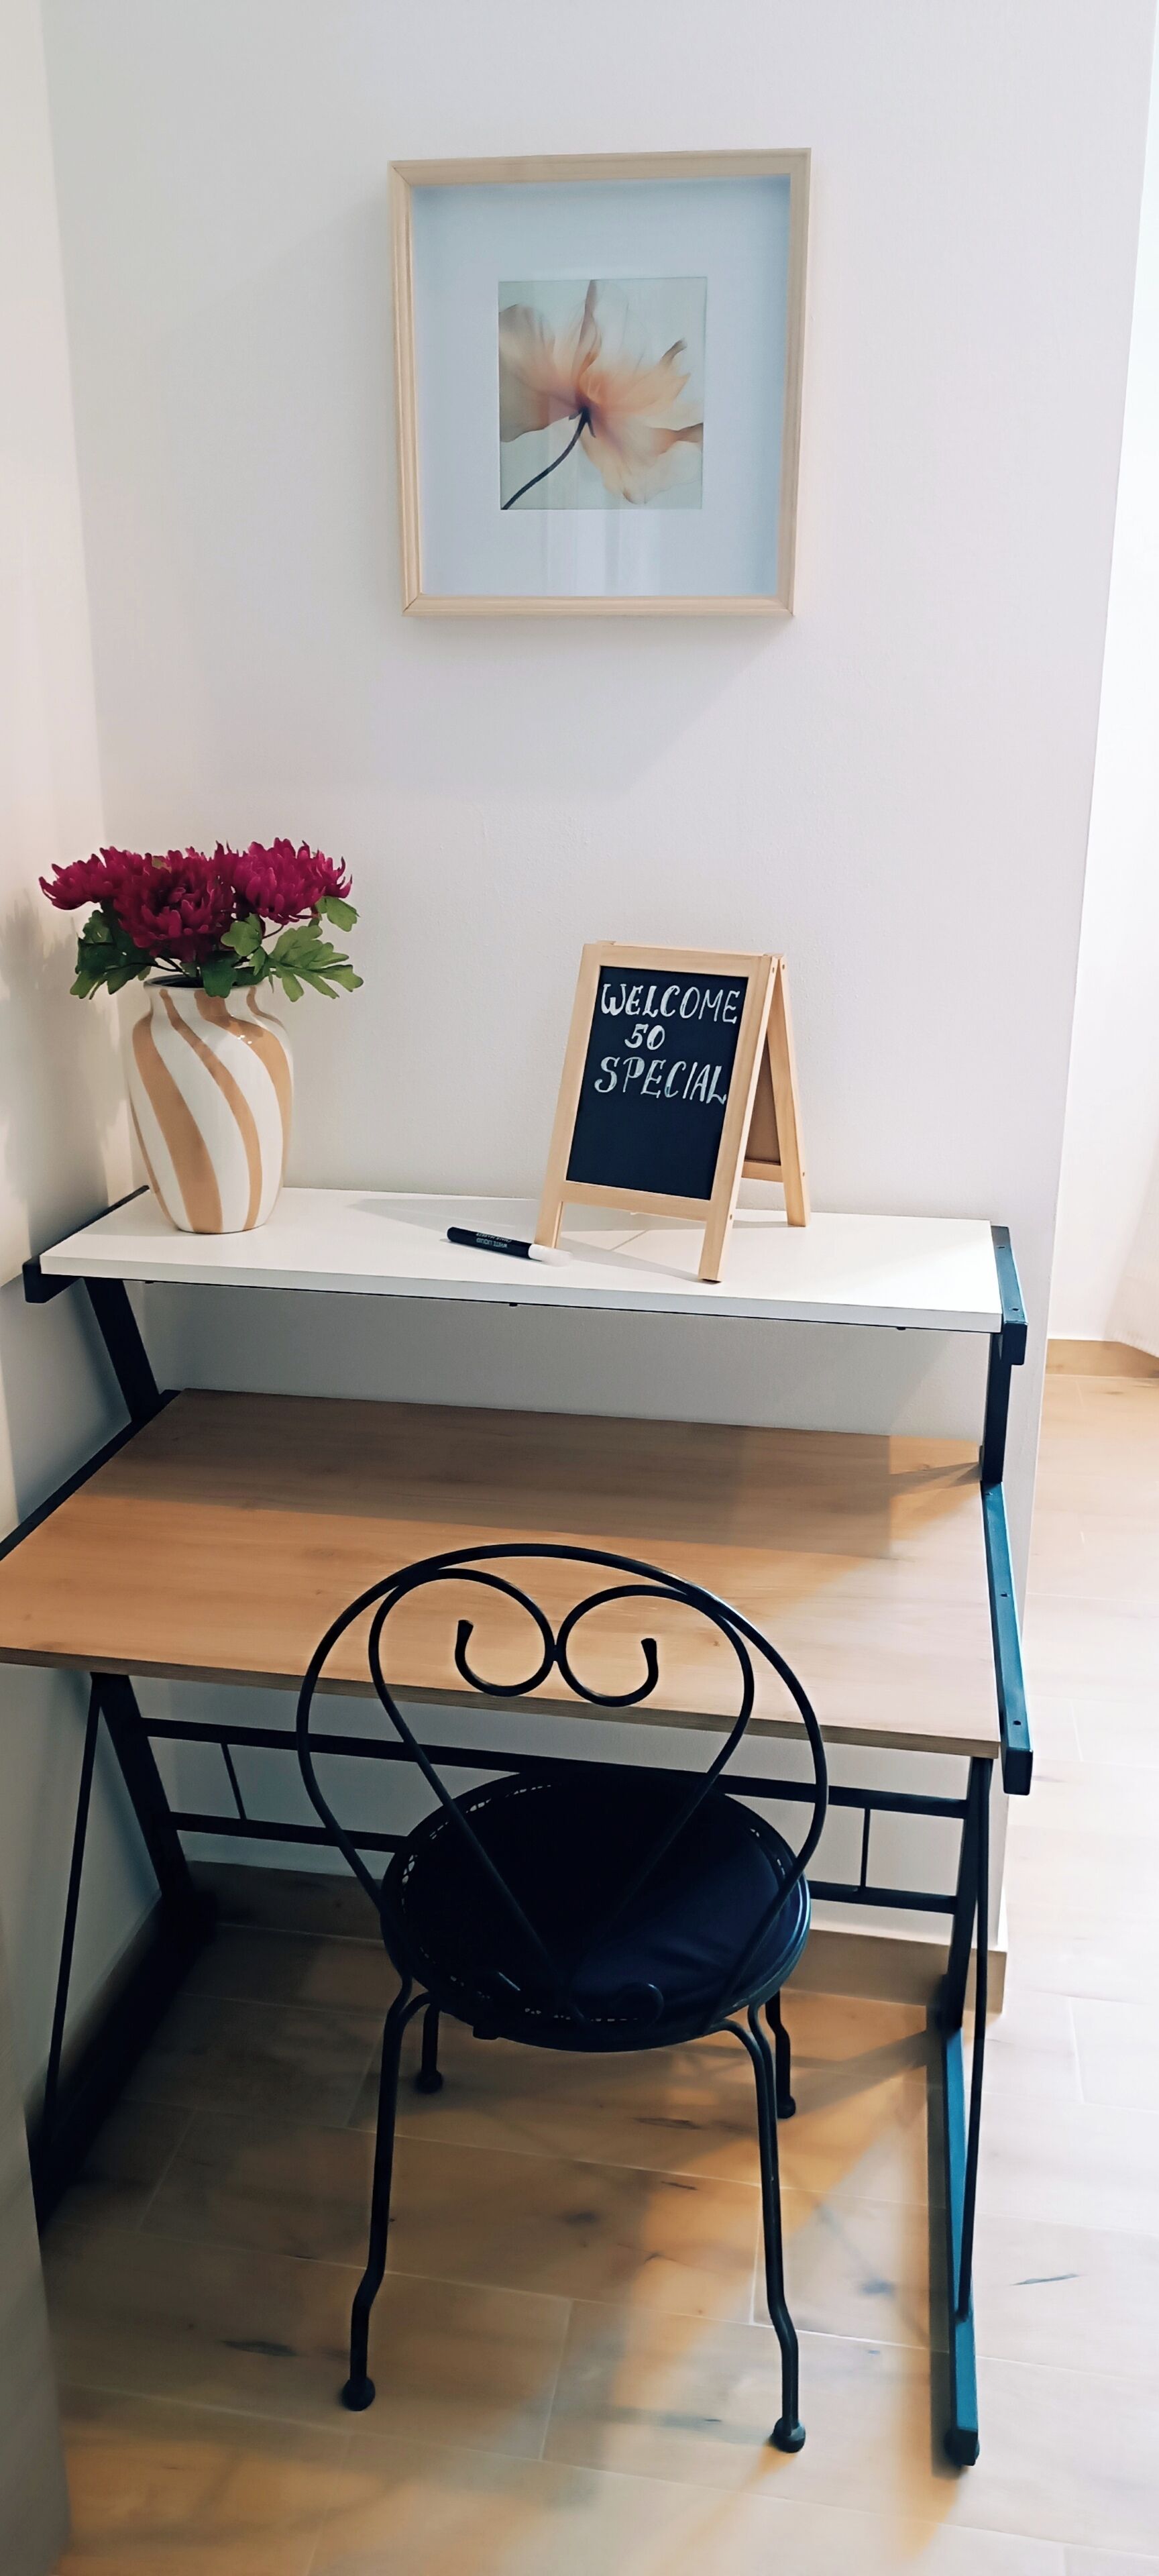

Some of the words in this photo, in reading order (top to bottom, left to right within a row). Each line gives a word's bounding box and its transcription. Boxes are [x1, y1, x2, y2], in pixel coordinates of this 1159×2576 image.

[601, 983, 740, 1024] WELCOME
[624, 1023, 666, 1051] 50
[594, 1056, 727, 1105] SPECIAL
